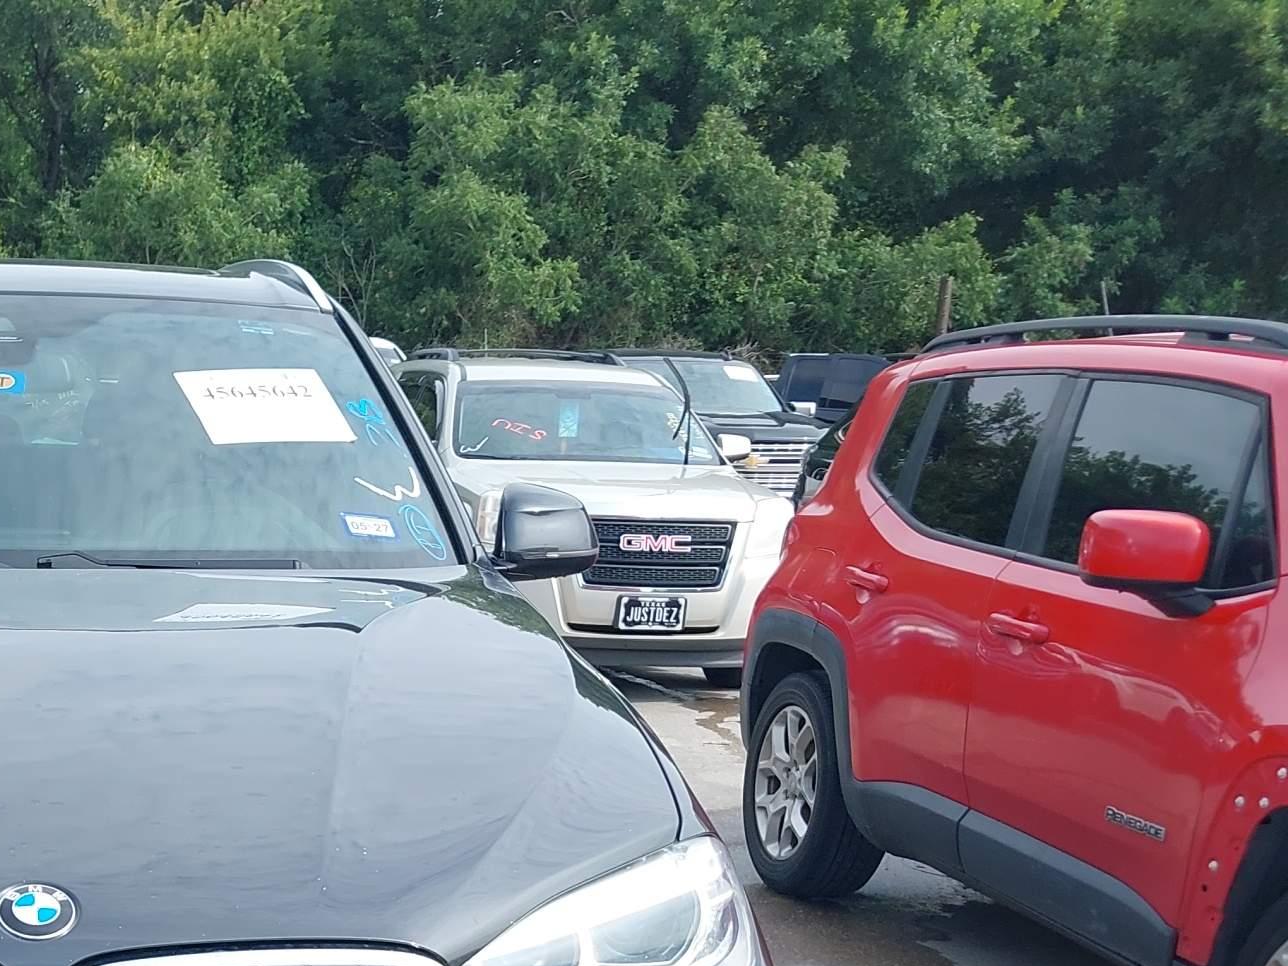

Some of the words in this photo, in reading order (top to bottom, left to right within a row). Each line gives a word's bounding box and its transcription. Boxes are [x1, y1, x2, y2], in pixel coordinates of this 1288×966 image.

[619, 533, 692, 552] GMC
[626, 606, 678, 622] JUSTDEZ
[1104, 805, 1166, 842] RENEGADE
